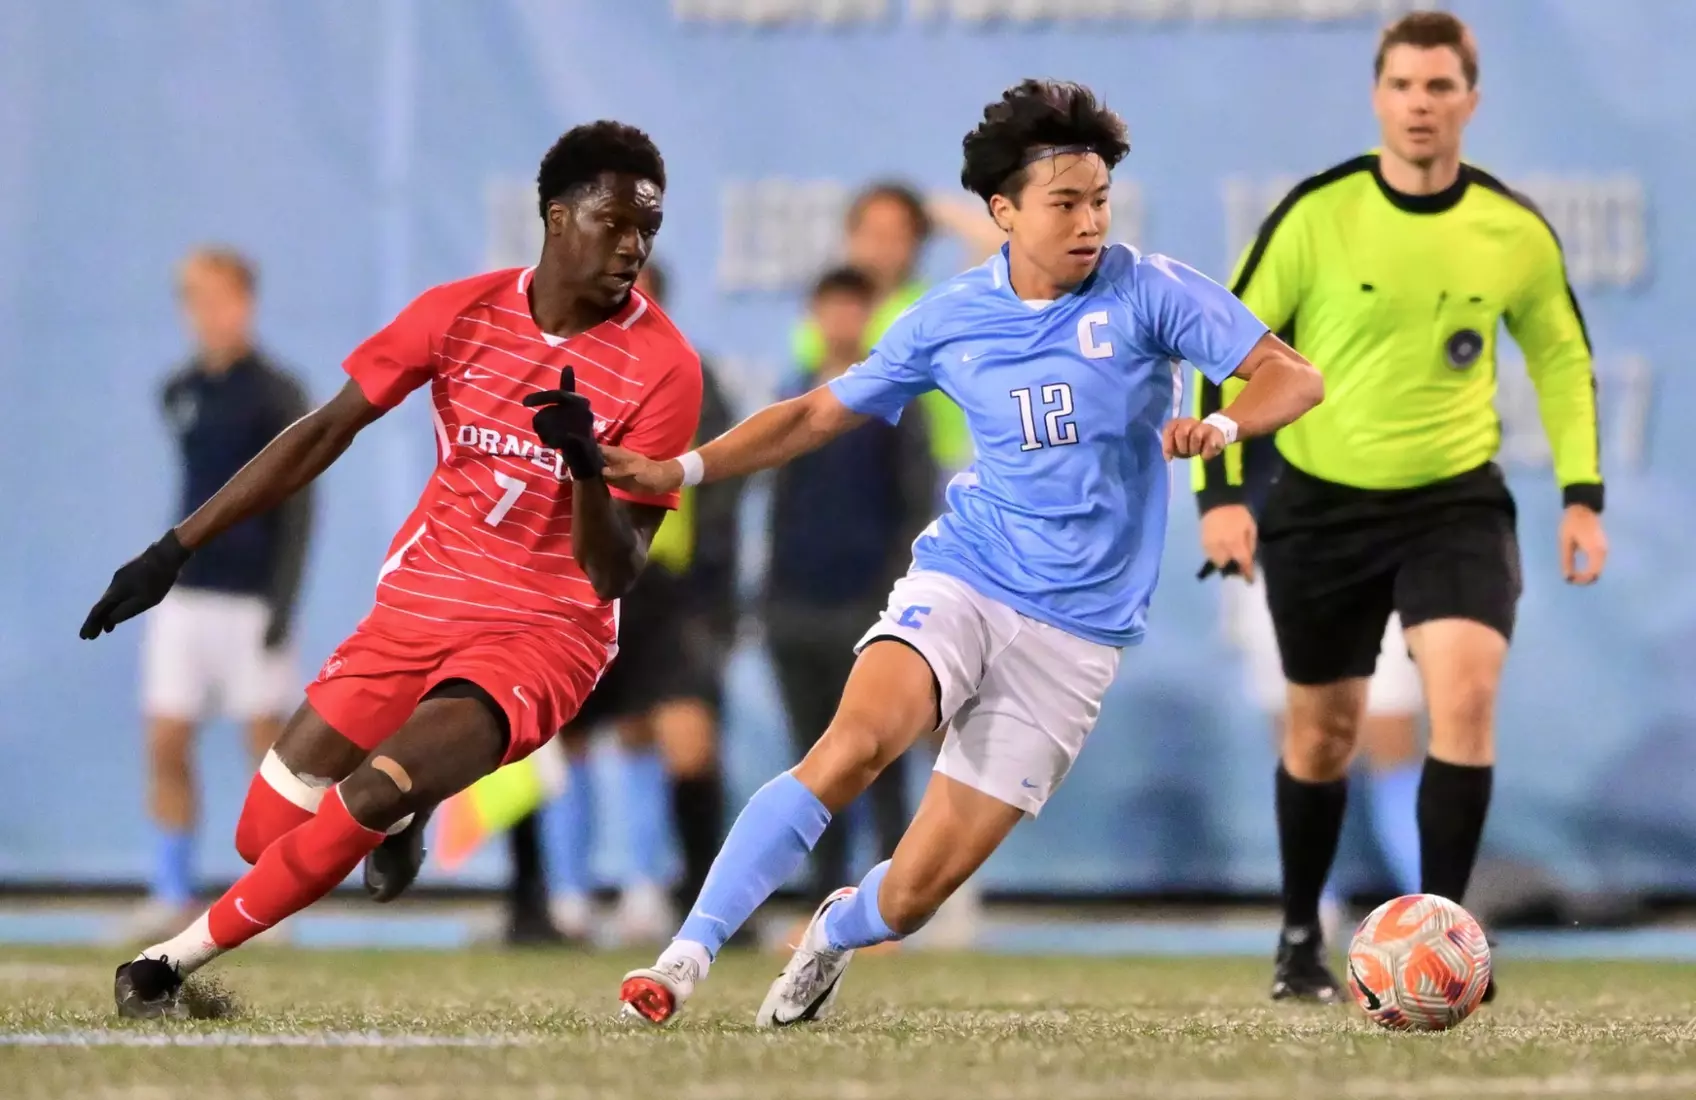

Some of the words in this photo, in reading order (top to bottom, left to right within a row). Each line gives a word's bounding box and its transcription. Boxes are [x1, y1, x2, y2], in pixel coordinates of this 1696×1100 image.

[1077, 310, 1115, 360] C
[1010, 382, 1079, 452] 12
[484, 469, 527, 527] 7
